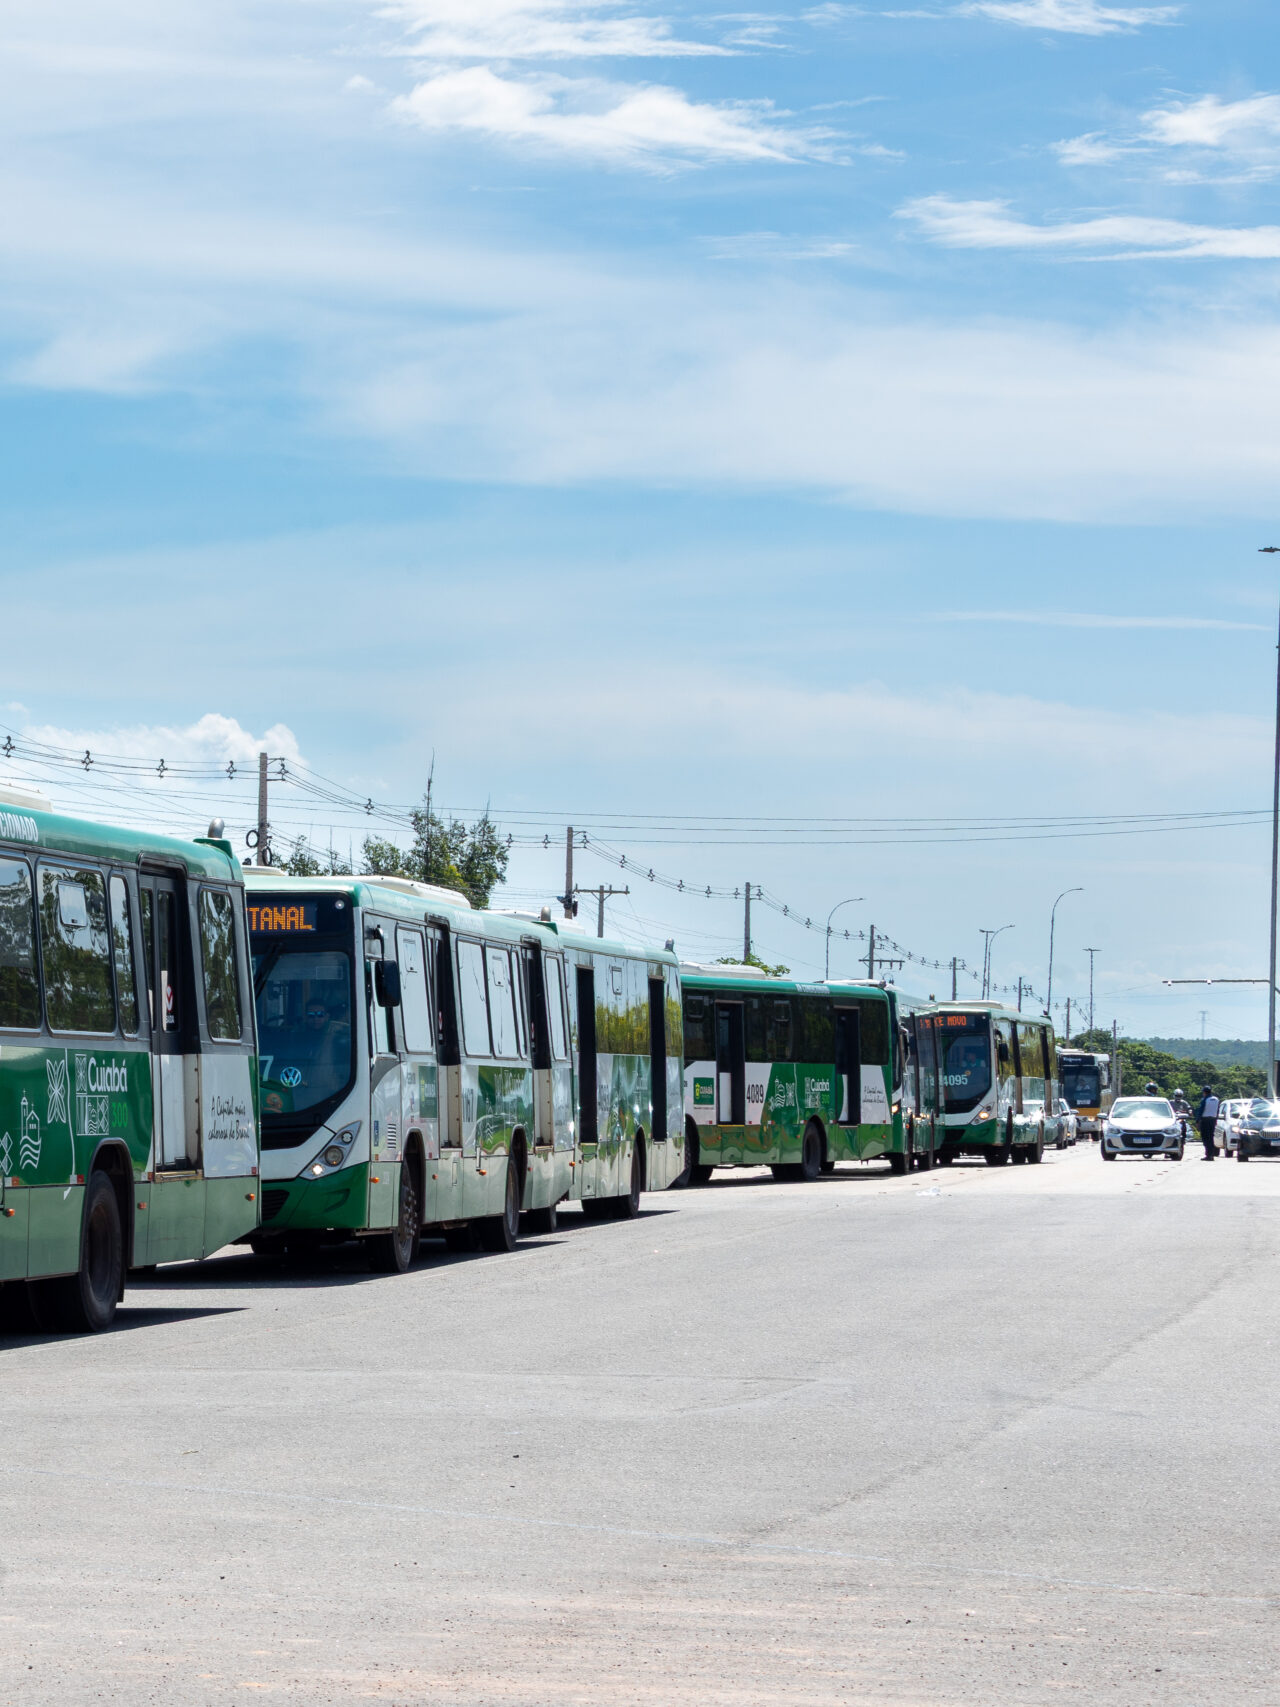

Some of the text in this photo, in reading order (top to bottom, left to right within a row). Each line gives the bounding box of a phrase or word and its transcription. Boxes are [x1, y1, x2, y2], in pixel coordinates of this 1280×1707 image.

[245, 906, 312, 931] TANAL
[87, 1056, 128, 1093] Cuiabá
[746, 1084, 765, 1104] 4089
[111, 1102, 128, 1128] 300
